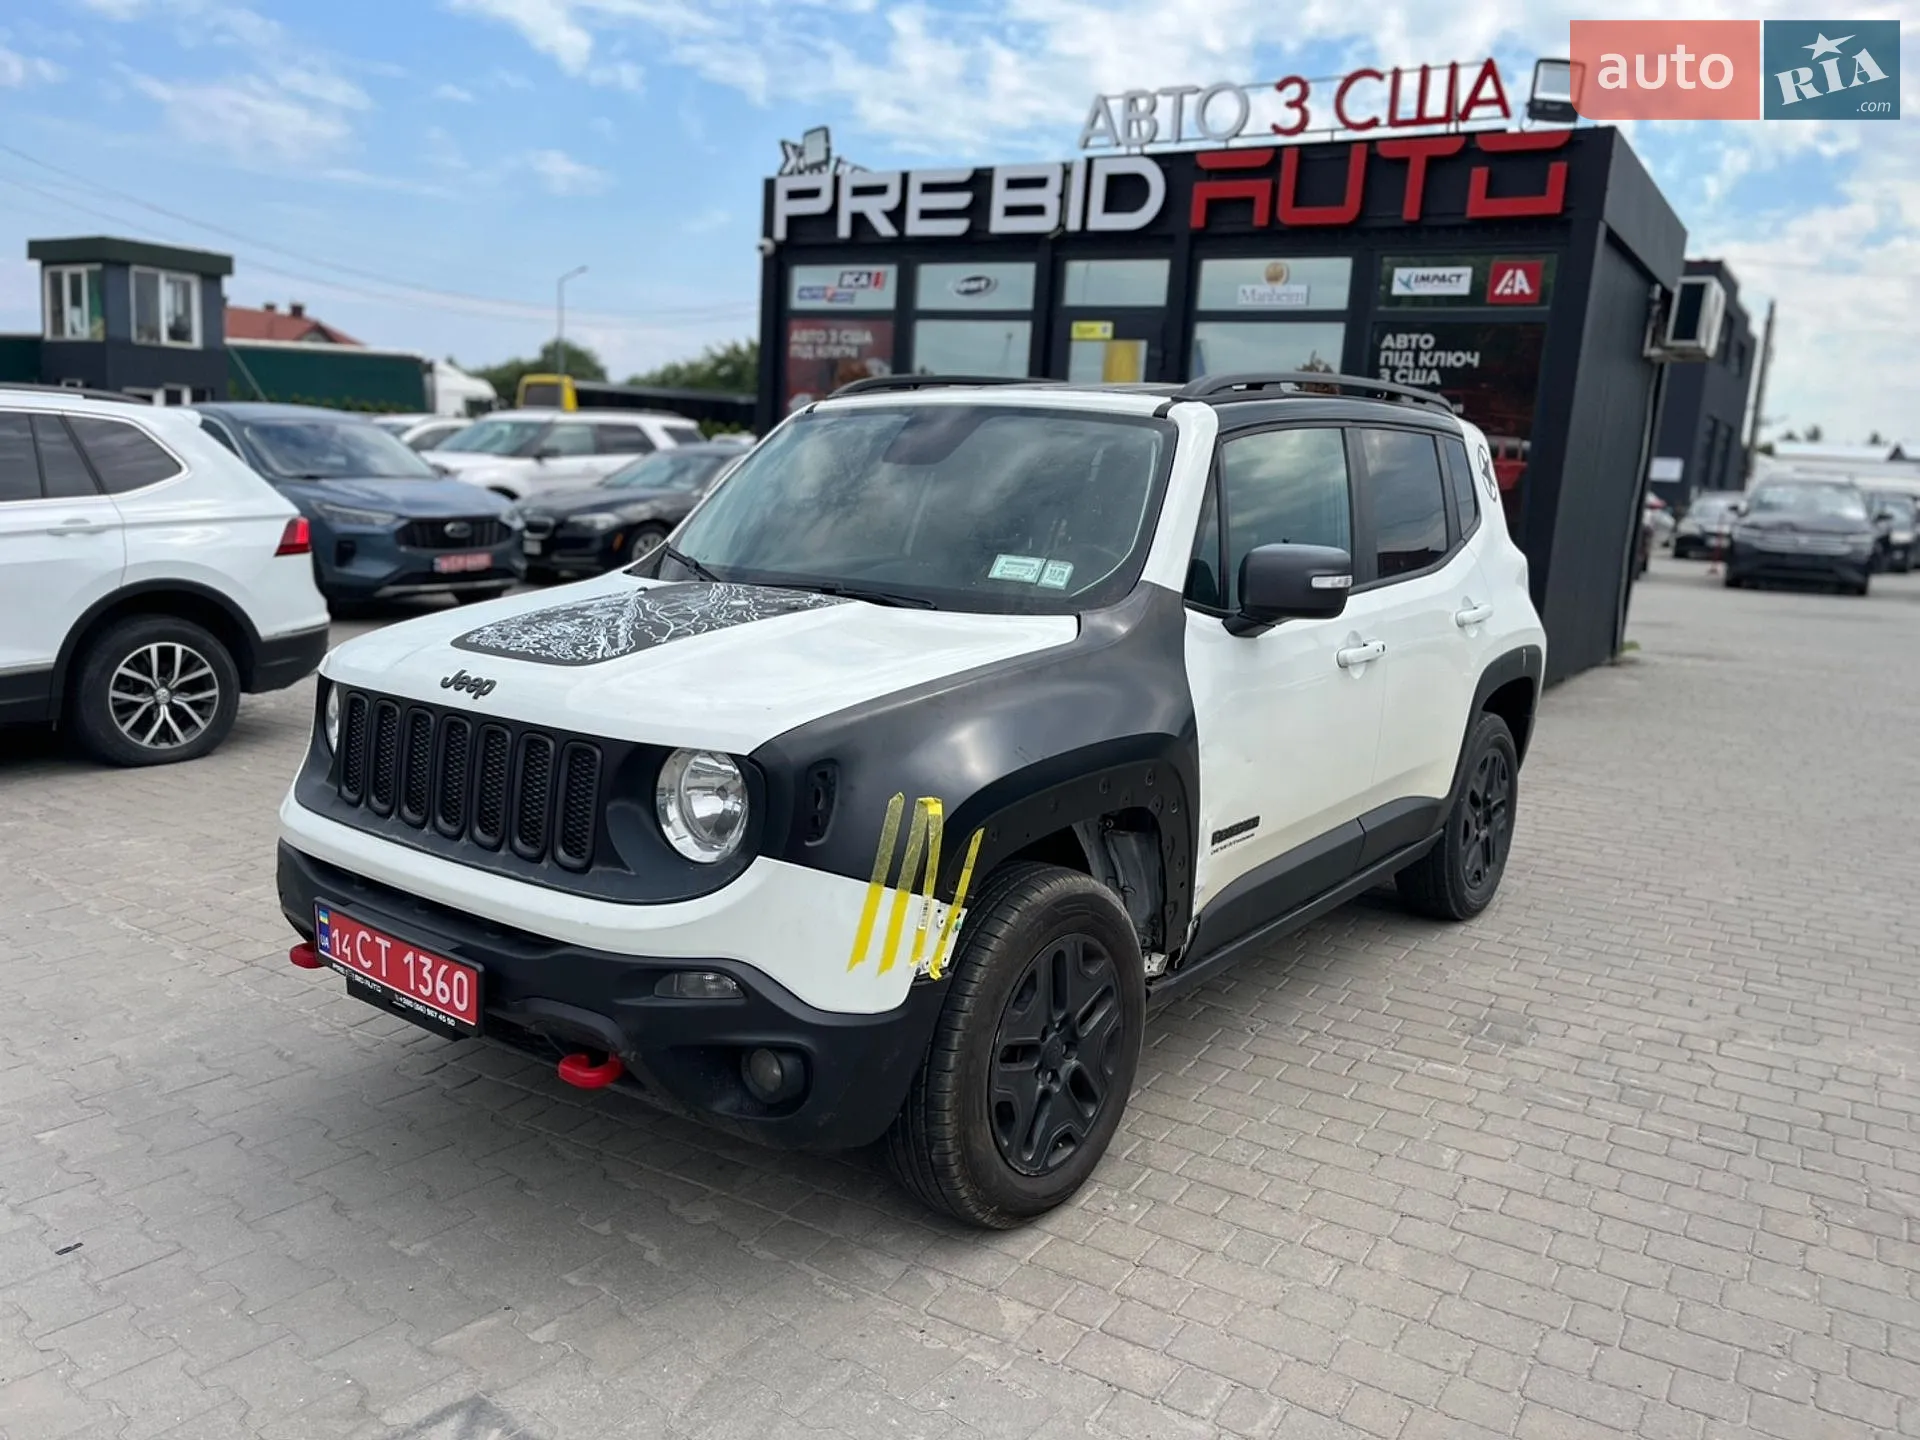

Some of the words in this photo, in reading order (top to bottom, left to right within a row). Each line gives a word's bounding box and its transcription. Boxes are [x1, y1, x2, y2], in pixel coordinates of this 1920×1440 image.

[1080, 82, 1250, 149] АВТО
[1334, 57, 1512, 131] США
[773, 169, 973, 241] PRE
[989, 156, 1167, 234] BID
[1190, 129, 1572, 228] AUTO
[1414, 273, 1463, 284] IMPACT
[1381, 333, 1435, 350] АВТО
[1379, 351, 1414, 368] ПІД
[1418, 351, 1481, 368] КЛЮЧ
[1394, 368, 1442, 385] США
[440, 668, 497, 699] Jeep
[403, 951, 469, 1012] 1360
